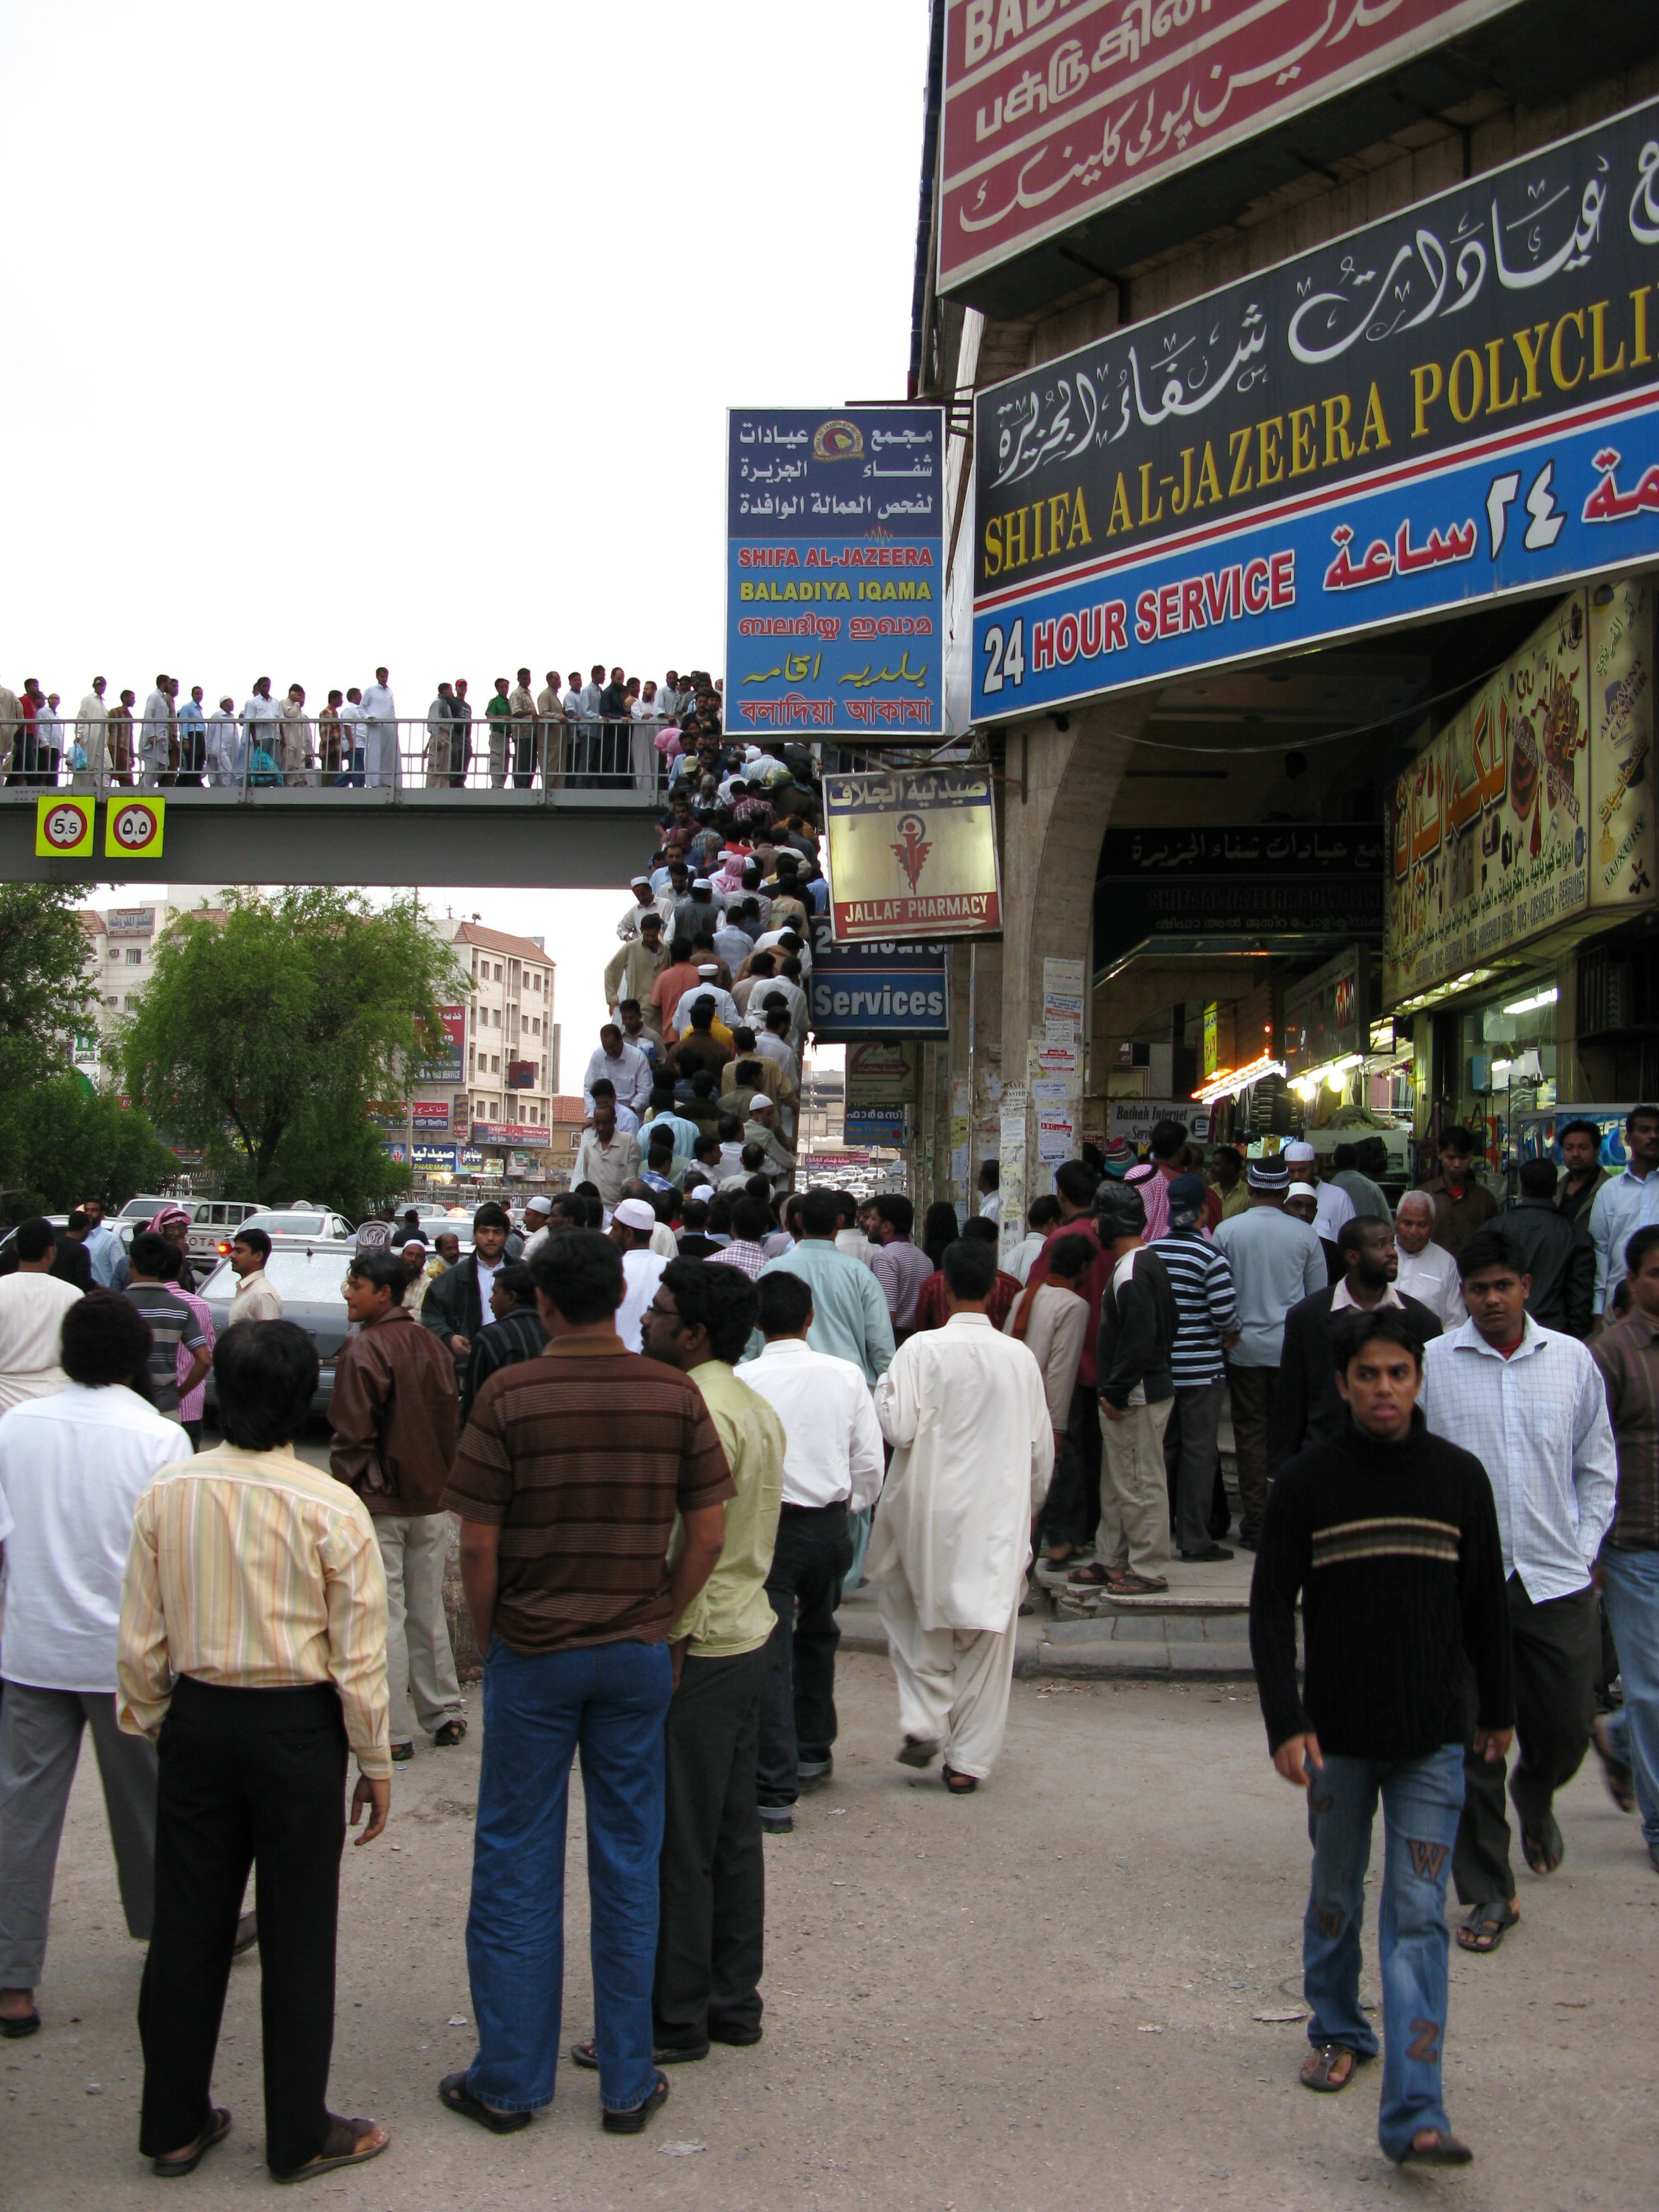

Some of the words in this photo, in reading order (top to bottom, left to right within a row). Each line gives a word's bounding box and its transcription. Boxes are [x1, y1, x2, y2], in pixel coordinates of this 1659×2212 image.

[739, 422, 809, 451] عيادات
[871, 427, 933, 451] مجمع
[984, 487, 1092, 578] SHIFA
[1107, 382, 1391, 538] AL-JAZEERA
[1411, 283, 1659, 438] POLYCLI
[741, 457, 808, 484] الجزيرة
[863, 454, 933, 478] شفاء
[740, 493, 805, 520] الوافدة
[812, 492, 872, 515] العمالة
[877, 495, 933, 521] لفحص
[738, 548, 799, 567] SHIFA
[806, 547, 933, 567] AL-JAZEERA
[1322, 518, 1477, 591] ساعة
[739, 581, 852, 602] BALADIYA
[858, 580, 933, 602] IQAMA
[849, 616, 933, 639] ഇഖാമ
[983, 617, 1025, 696] 24
[1032, 598, 1128, 673] HOUR
[1135, 549, 1295, 644] SERVICE
[1600, 651, 1642, 740] ALGARNY
[1609, 671, 1648, 740] CENTER
[844, 697, 933, 726] আকামা
[1509, 716, 1547, 775] ALGARNY
[1547, 762, 1582, 825] CENTER
[830, 777, 903, 811] الجلاف
[907, 775, 988, 806] صيدلية
[53, 818, 77, 834] 5.5
[1603, 813, 1645, 889] LUXURY
[844, 900, 901, 924] JALLAF
[908, 895, 988, 919] PHARMACY
[1300, 888, 1383, 908] POLYCLIN
[814, 985, 943, 1017] Services
[442, 1070, 461, 1079] SERVICE
[1117, 1106, 1150, 1121] Bathah
[1152, 1107, 1188, 1121] Internet
[1133, 1125, 1154, 1139] Servi
[414, 1163, 453, 1171] PHARMACY
[189, 1237, 216, 1247] OTA
[1407, 1839, 1449, 1879] W
